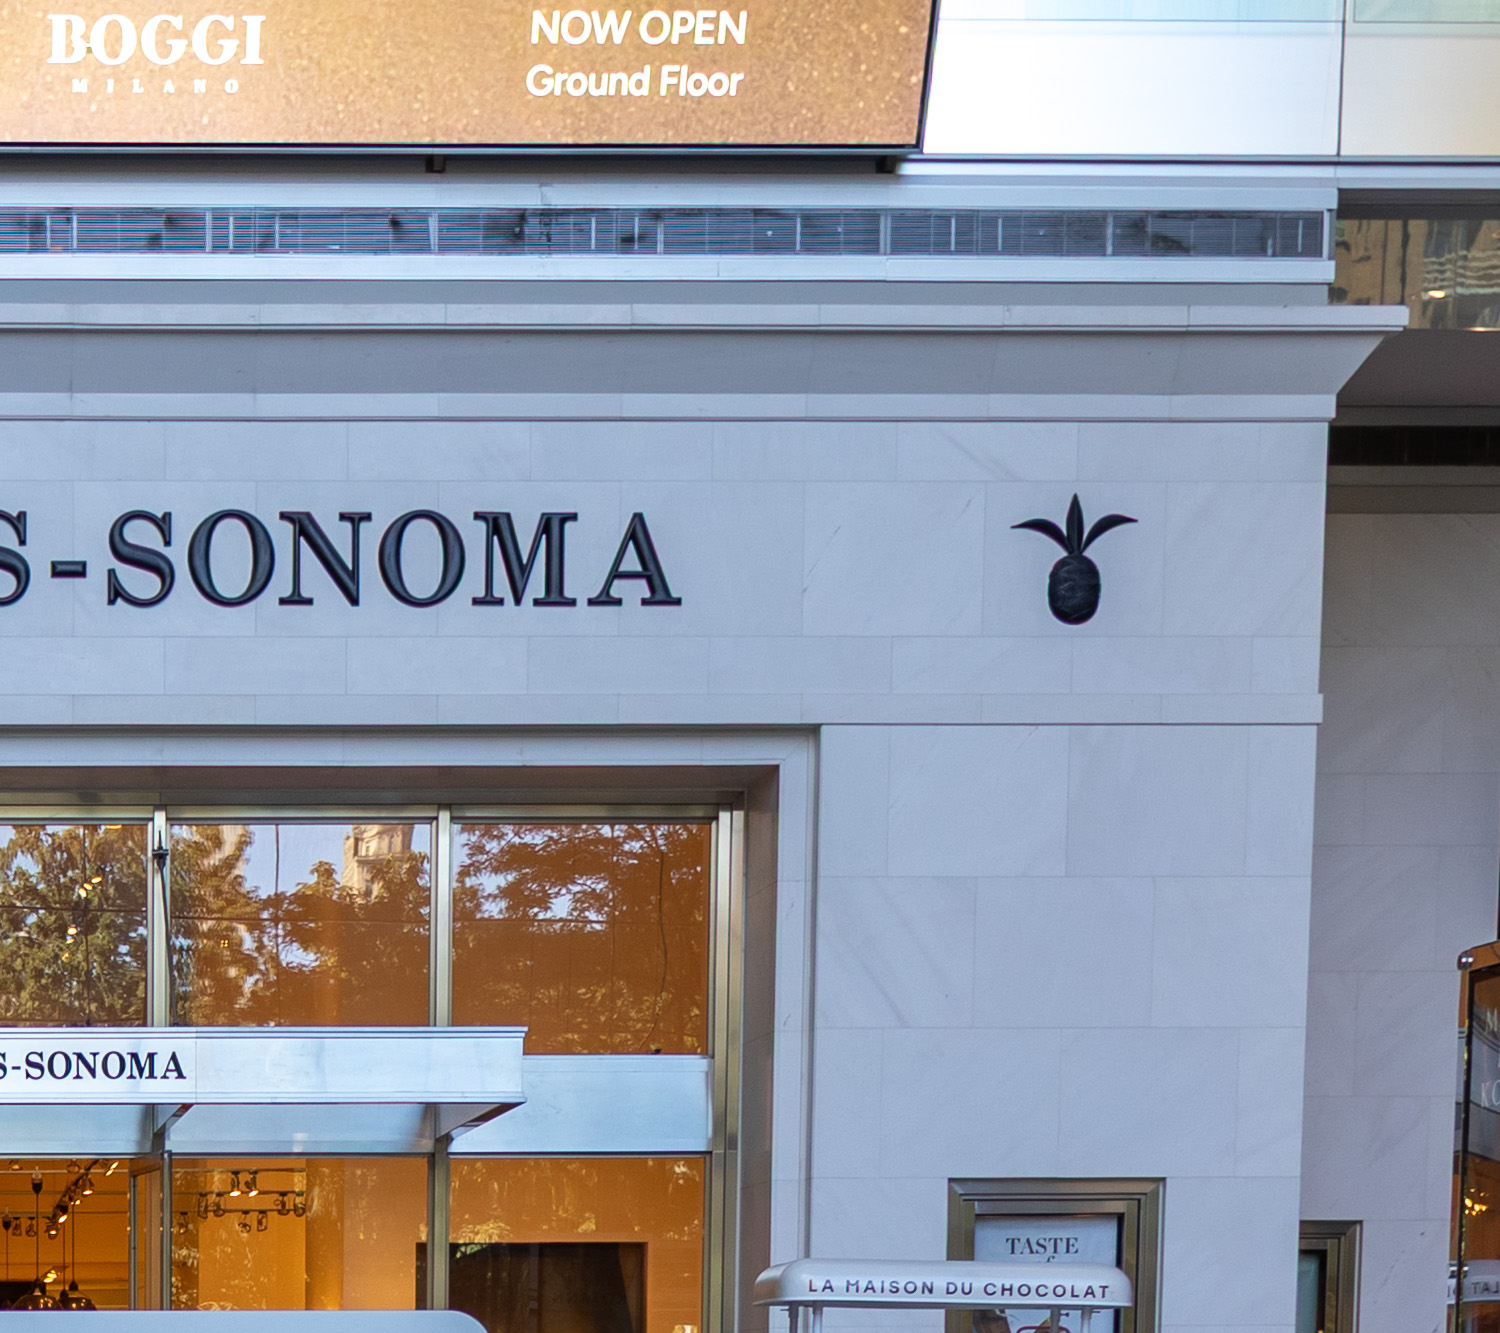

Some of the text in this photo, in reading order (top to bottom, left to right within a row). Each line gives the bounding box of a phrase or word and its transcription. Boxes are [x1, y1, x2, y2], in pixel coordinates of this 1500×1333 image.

[47, 13, 264, 66] BOGGI
[530, 10, 746, 45] NOW OPEN
[72, 76, 244, 95] MILANO
[525, 62, 743, 101] Ground Floor
[1006, 1236, 1079, 1255] TASTE
[808, 1279, 1110, 1299] LA MAISON DU CHOCOLAT
